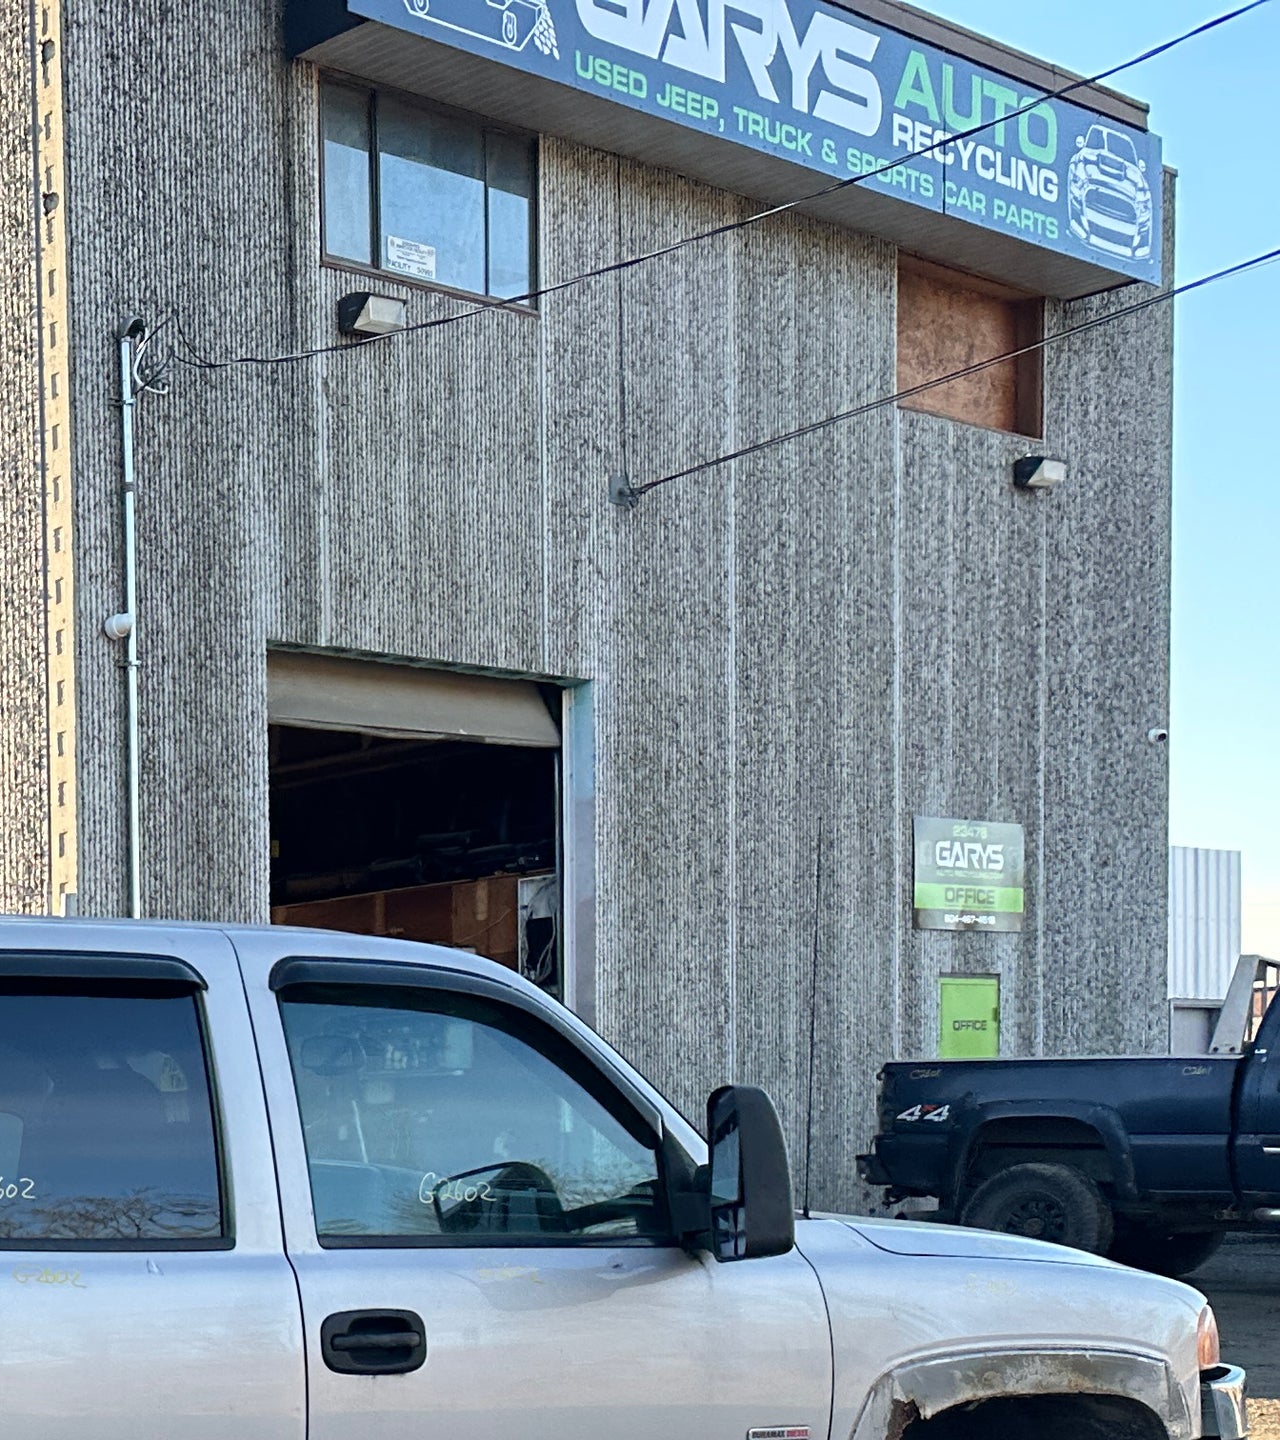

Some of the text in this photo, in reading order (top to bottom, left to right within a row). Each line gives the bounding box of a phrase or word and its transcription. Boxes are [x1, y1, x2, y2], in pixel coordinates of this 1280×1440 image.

[893, 49, 1058, 165] AUTO
[574, 50, 1059, 240] USED JEEP, TRUCK & SPORTS CAR PARTS
[892, 112, 1059, 203] RECYCLING
[935, 841, 1004, 870] GARYS
[944, 887, 995, 905] OFFICE
[952, 1020, 987, 1031] OFFICE
[419, 1171, 497, 1204] G2602
